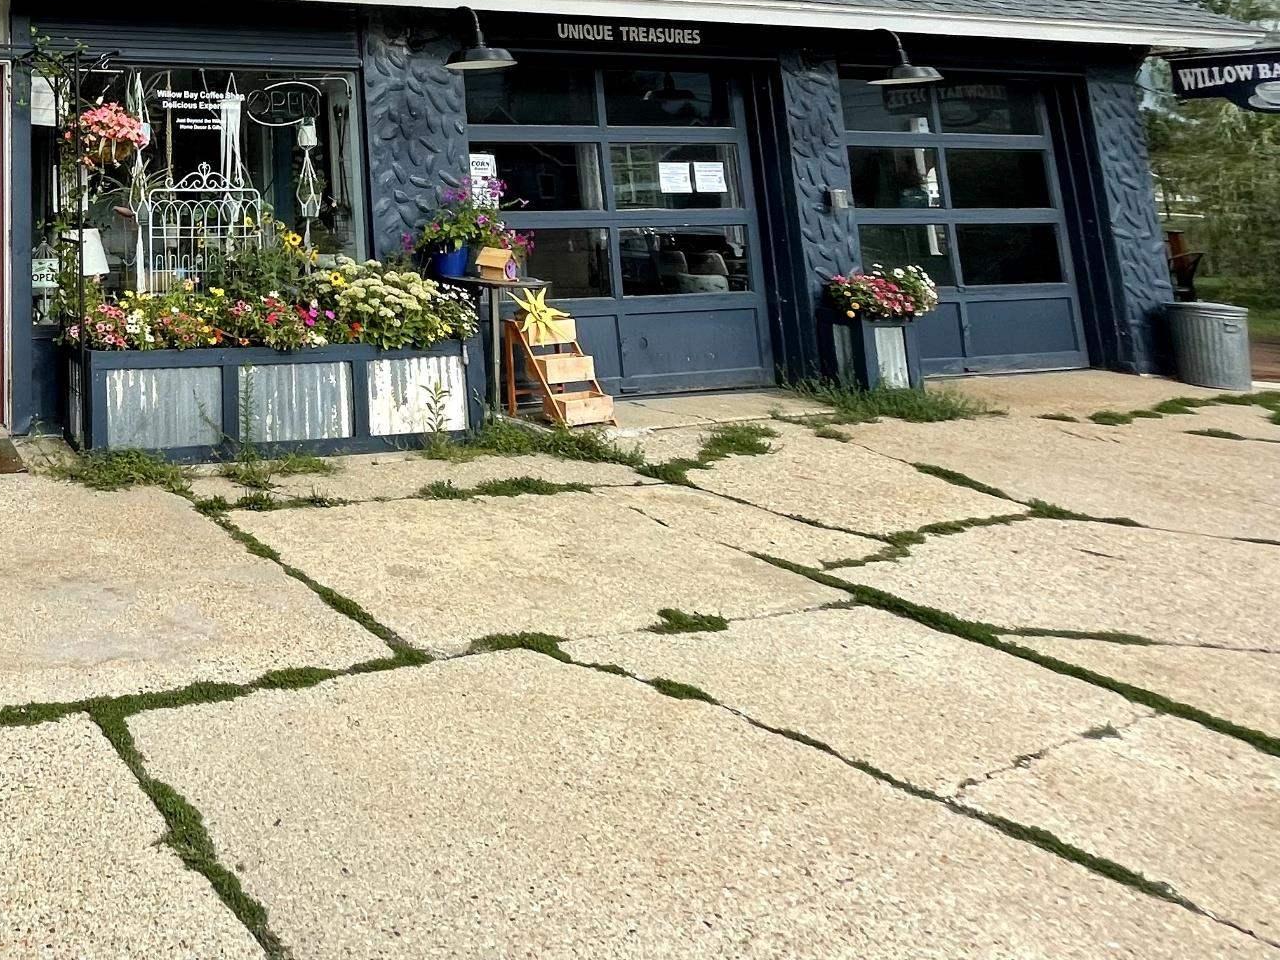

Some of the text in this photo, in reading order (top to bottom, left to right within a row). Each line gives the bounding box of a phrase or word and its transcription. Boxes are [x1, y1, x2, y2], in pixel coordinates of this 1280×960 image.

[557, 23, 701, 44] UNIQUE TREASURES
[1177, 65, 1253, 90] WILLOW
[157, 90, 182, 99] Willow
[184, 91, 198, 100] Bay
[200, 91, 224, 100] Coffee
[163, 101, 240, 110] Delicious Experi
[247, 90, 320, 116] OPEN
